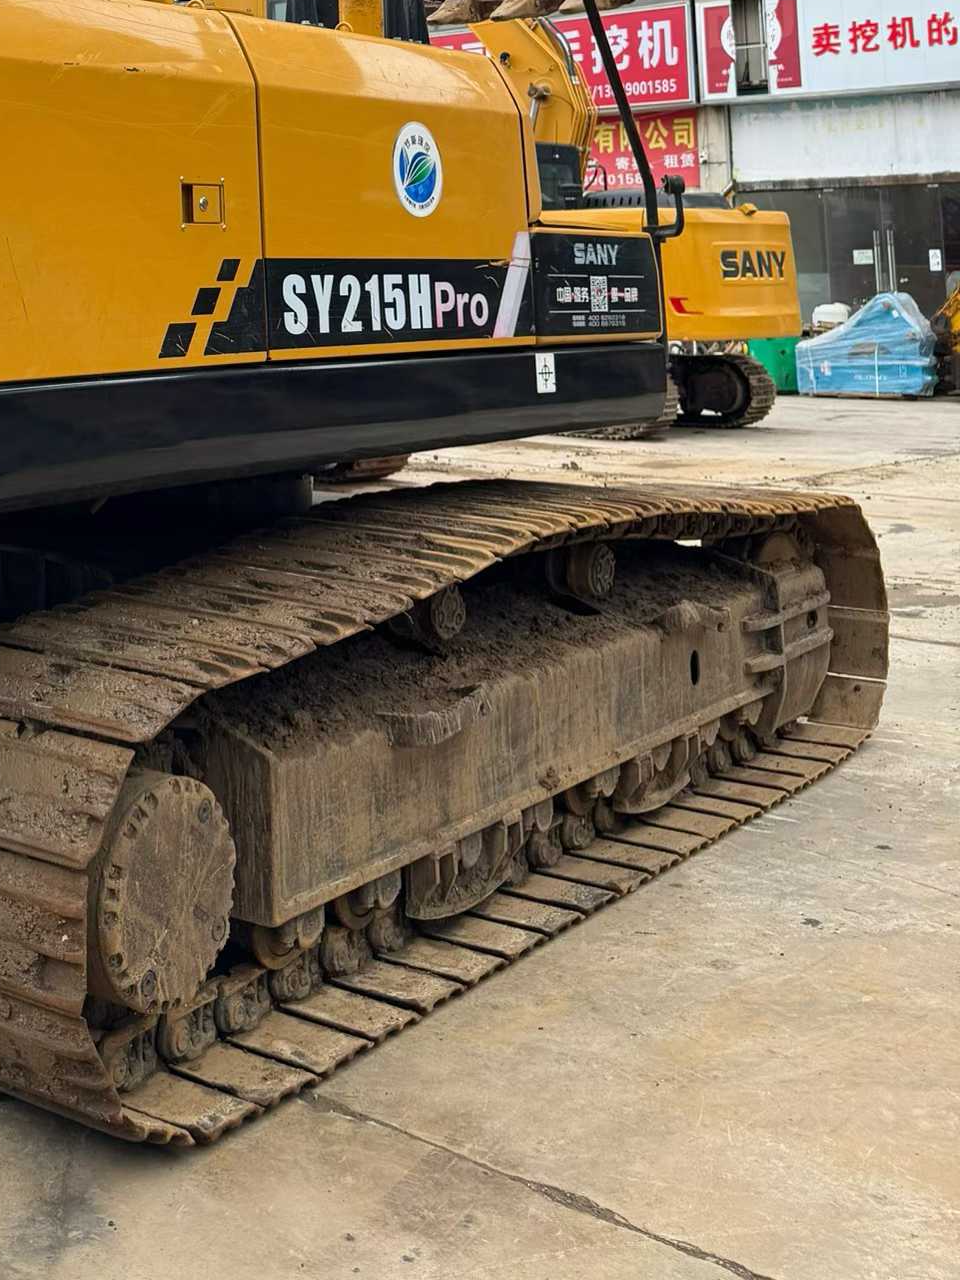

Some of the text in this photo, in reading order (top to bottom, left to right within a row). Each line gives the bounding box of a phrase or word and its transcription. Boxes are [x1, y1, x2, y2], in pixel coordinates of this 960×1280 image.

[811, 11, 958, 57] 卖挖机的
[664, 152, 695, 169] 租赁
[573, 243, 619, 266] SANY
[720, 249, 786, 280] SANY
